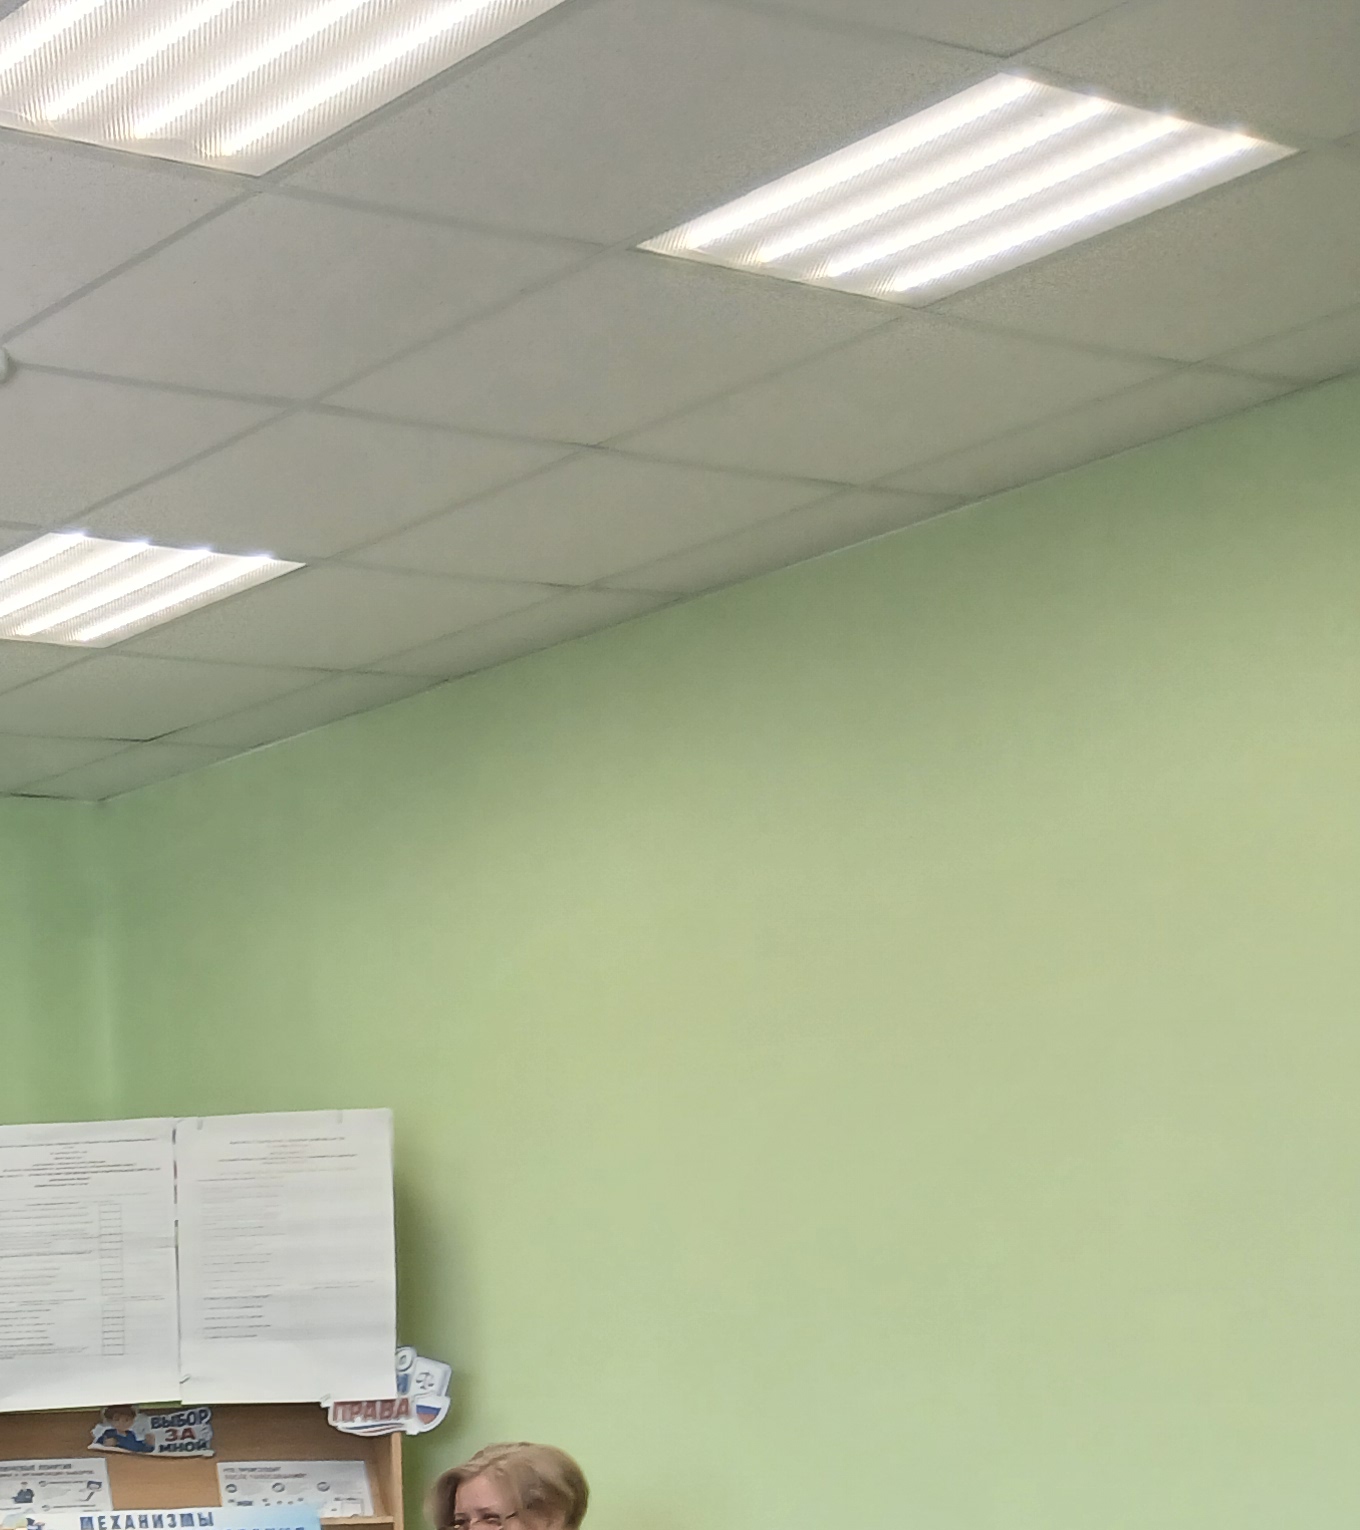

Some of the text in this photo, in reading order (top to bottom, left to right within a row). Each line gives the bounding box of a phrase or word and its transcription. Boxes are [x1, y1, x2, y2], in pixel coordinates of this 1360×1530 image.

[151, 1409, 209, 1429] ВЫБОР
[333, 1398, 409, 1423] ПРАВА
[165, 1428, 196, 1442] ЗА
[80, 1512, 213, 1530] МЕХАНИЗМЫ
